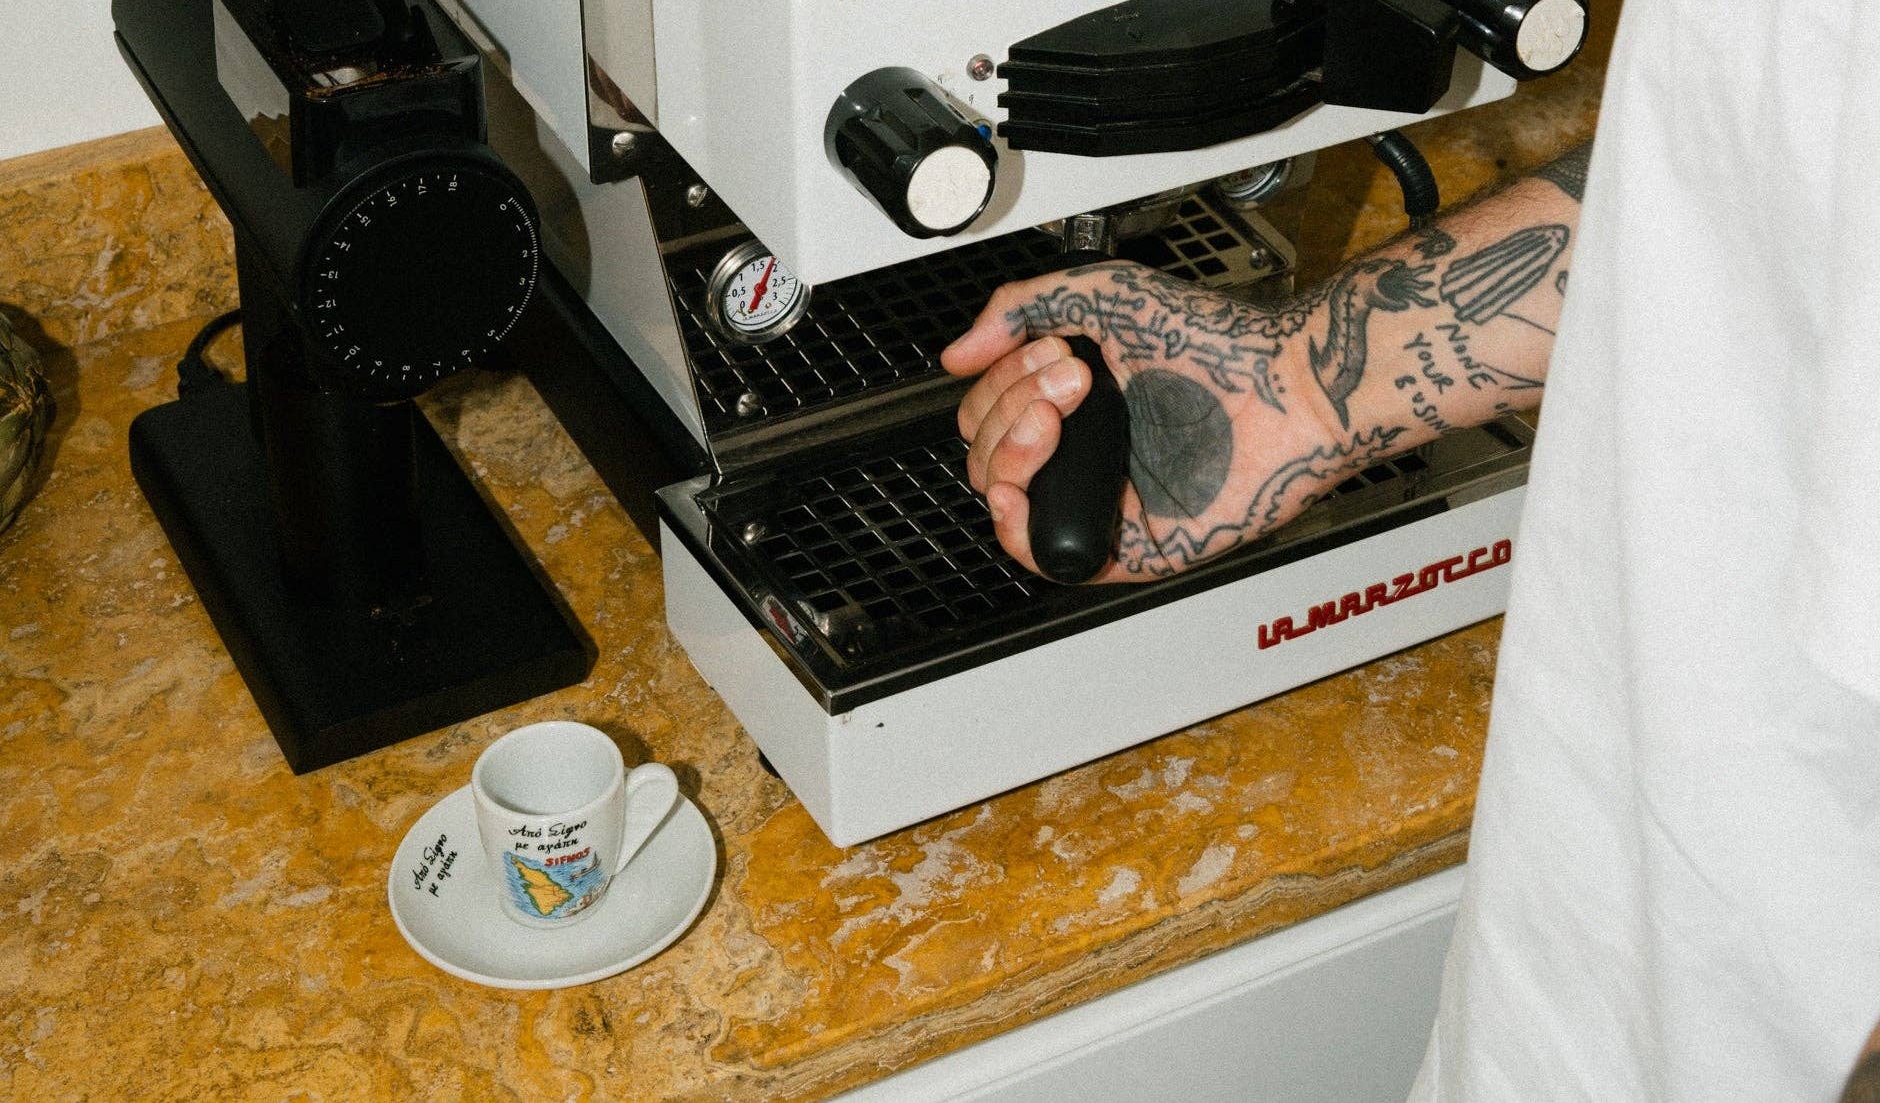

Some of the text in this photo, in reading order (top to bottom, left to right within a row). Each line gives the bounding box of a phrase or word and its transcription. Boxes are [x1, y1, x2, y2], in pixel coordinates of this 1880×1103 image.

[418, 185, 428, 195] 17
[448, 181, 458, 191] 18
[387, 195, 398, 207] 16
[499, 203, 508, 211] 0
[360, 215, 372, 226] 15
[515, 224, 521, 232] 1
[340, 241, 351, 251] 14
[522, 249, 528, 258] 2
[751, 260, 765, 273] 1,5
[772, 263, 778, 273] 2
[327, 270, 339, 279] 13
[740, 273, 744, 282] 1
[519, 277, 525, 286] 3
[772, 276, 786, 288] 2,5
[732, 287, 746, 299] 0,5
[772, 292, 778, 301] 3
[325, 299, 337, 308] 12
[740, 300, 746, 309] 0
[507, 305, 514, 313] 4
[333, 324, 345, 334] 11
[487, 329, 496, 337] 5
[349, 345, 361, 355] 10
[1435, 323, 1499, 391] NONE
[1403, 332, 1454, 395] YOUR
[1258, 538, 1512, 650] LA MARZOCCO
[508, 819, 587, 839] Από Σίφνο
[515, 838, 579, 854] με αγάπη
[544, 846, 591, 867] SIFNOS
[412, 862, 429, 890] Από
[428, 882, 440, 898] με
